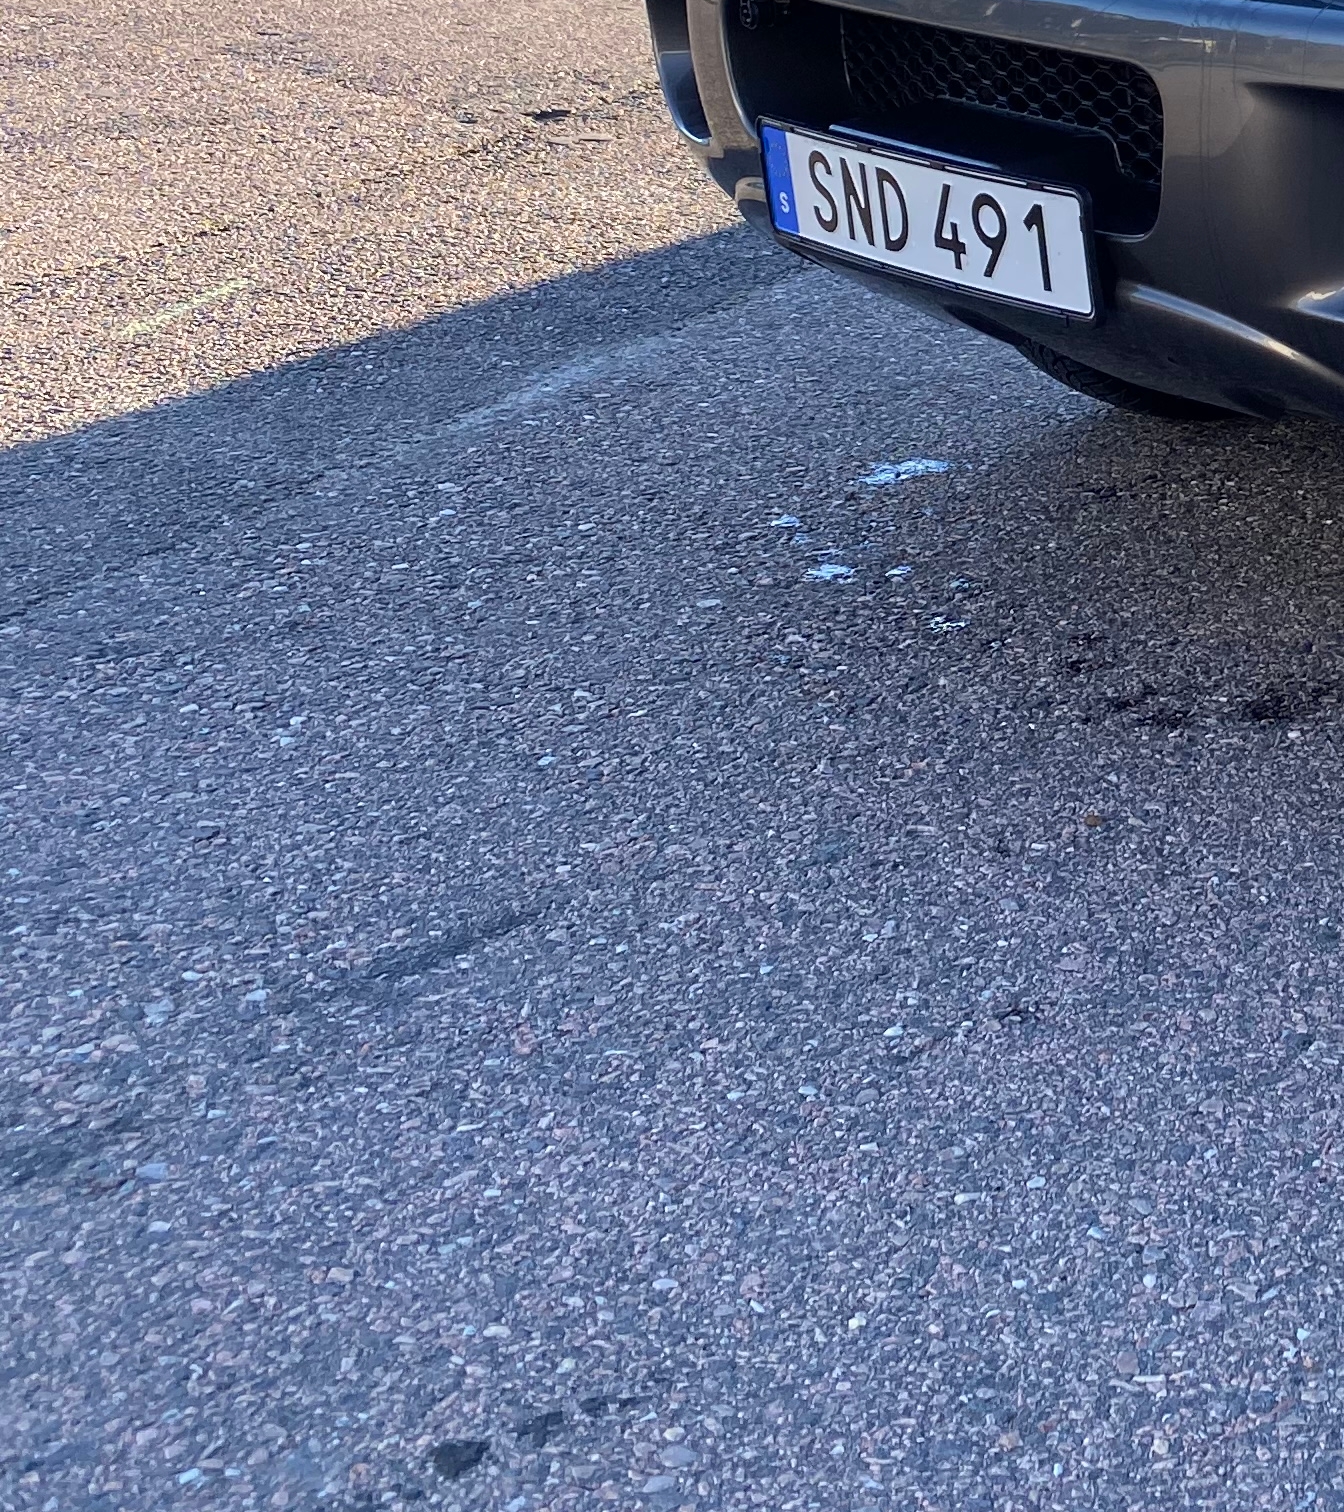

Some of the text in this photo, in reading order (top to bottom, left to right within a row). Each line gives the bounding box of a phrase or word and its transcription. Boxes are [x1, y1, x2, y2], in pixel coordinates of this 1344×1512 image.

[779, 191, 790, 214] S
[808, 150, 1053, 292] SND 491
